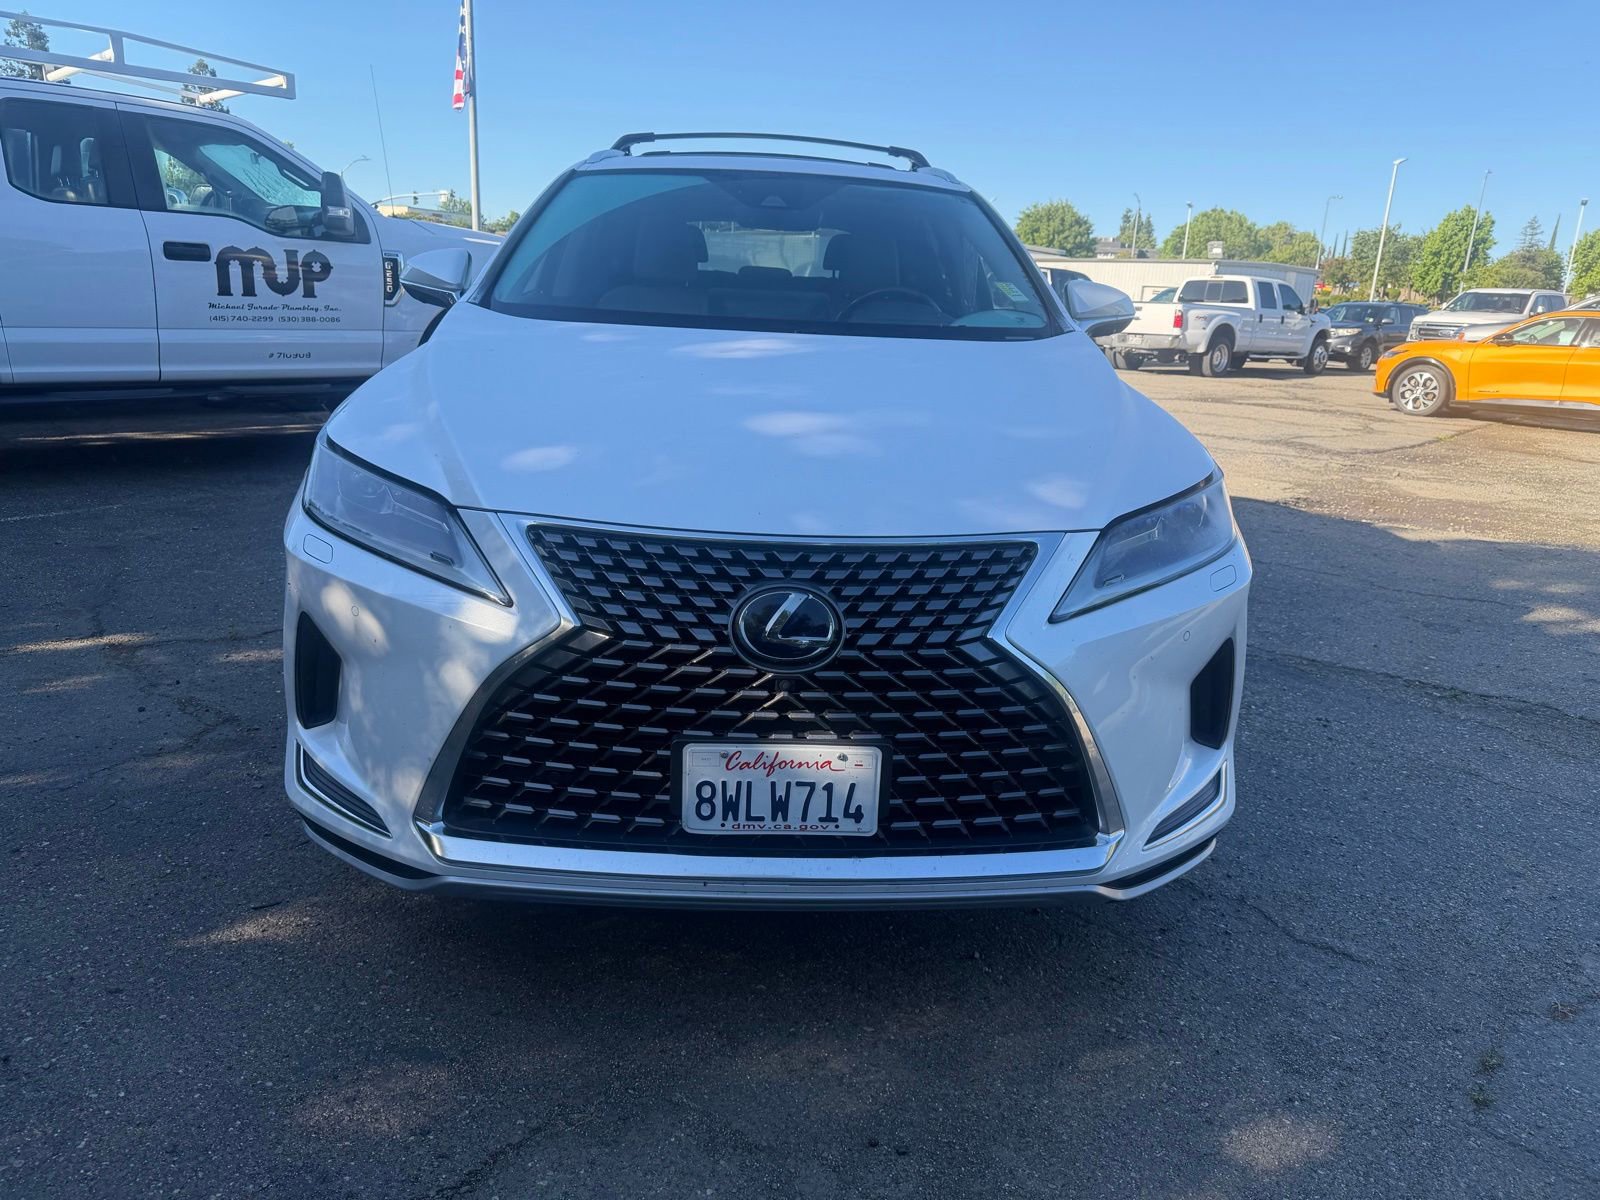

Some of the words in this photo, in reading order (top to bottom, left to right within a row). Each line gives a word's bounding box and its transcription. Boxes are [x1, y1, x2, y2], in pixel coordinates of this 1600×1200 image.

[208, 302, 246, 310] Michael
[247, 303, 281, 311] Jurado
[725, 750, 846, 777] California
[695, 780, 865, 824] 8WLW714
[731, 822, 830, 832] dmv.ca.gov
